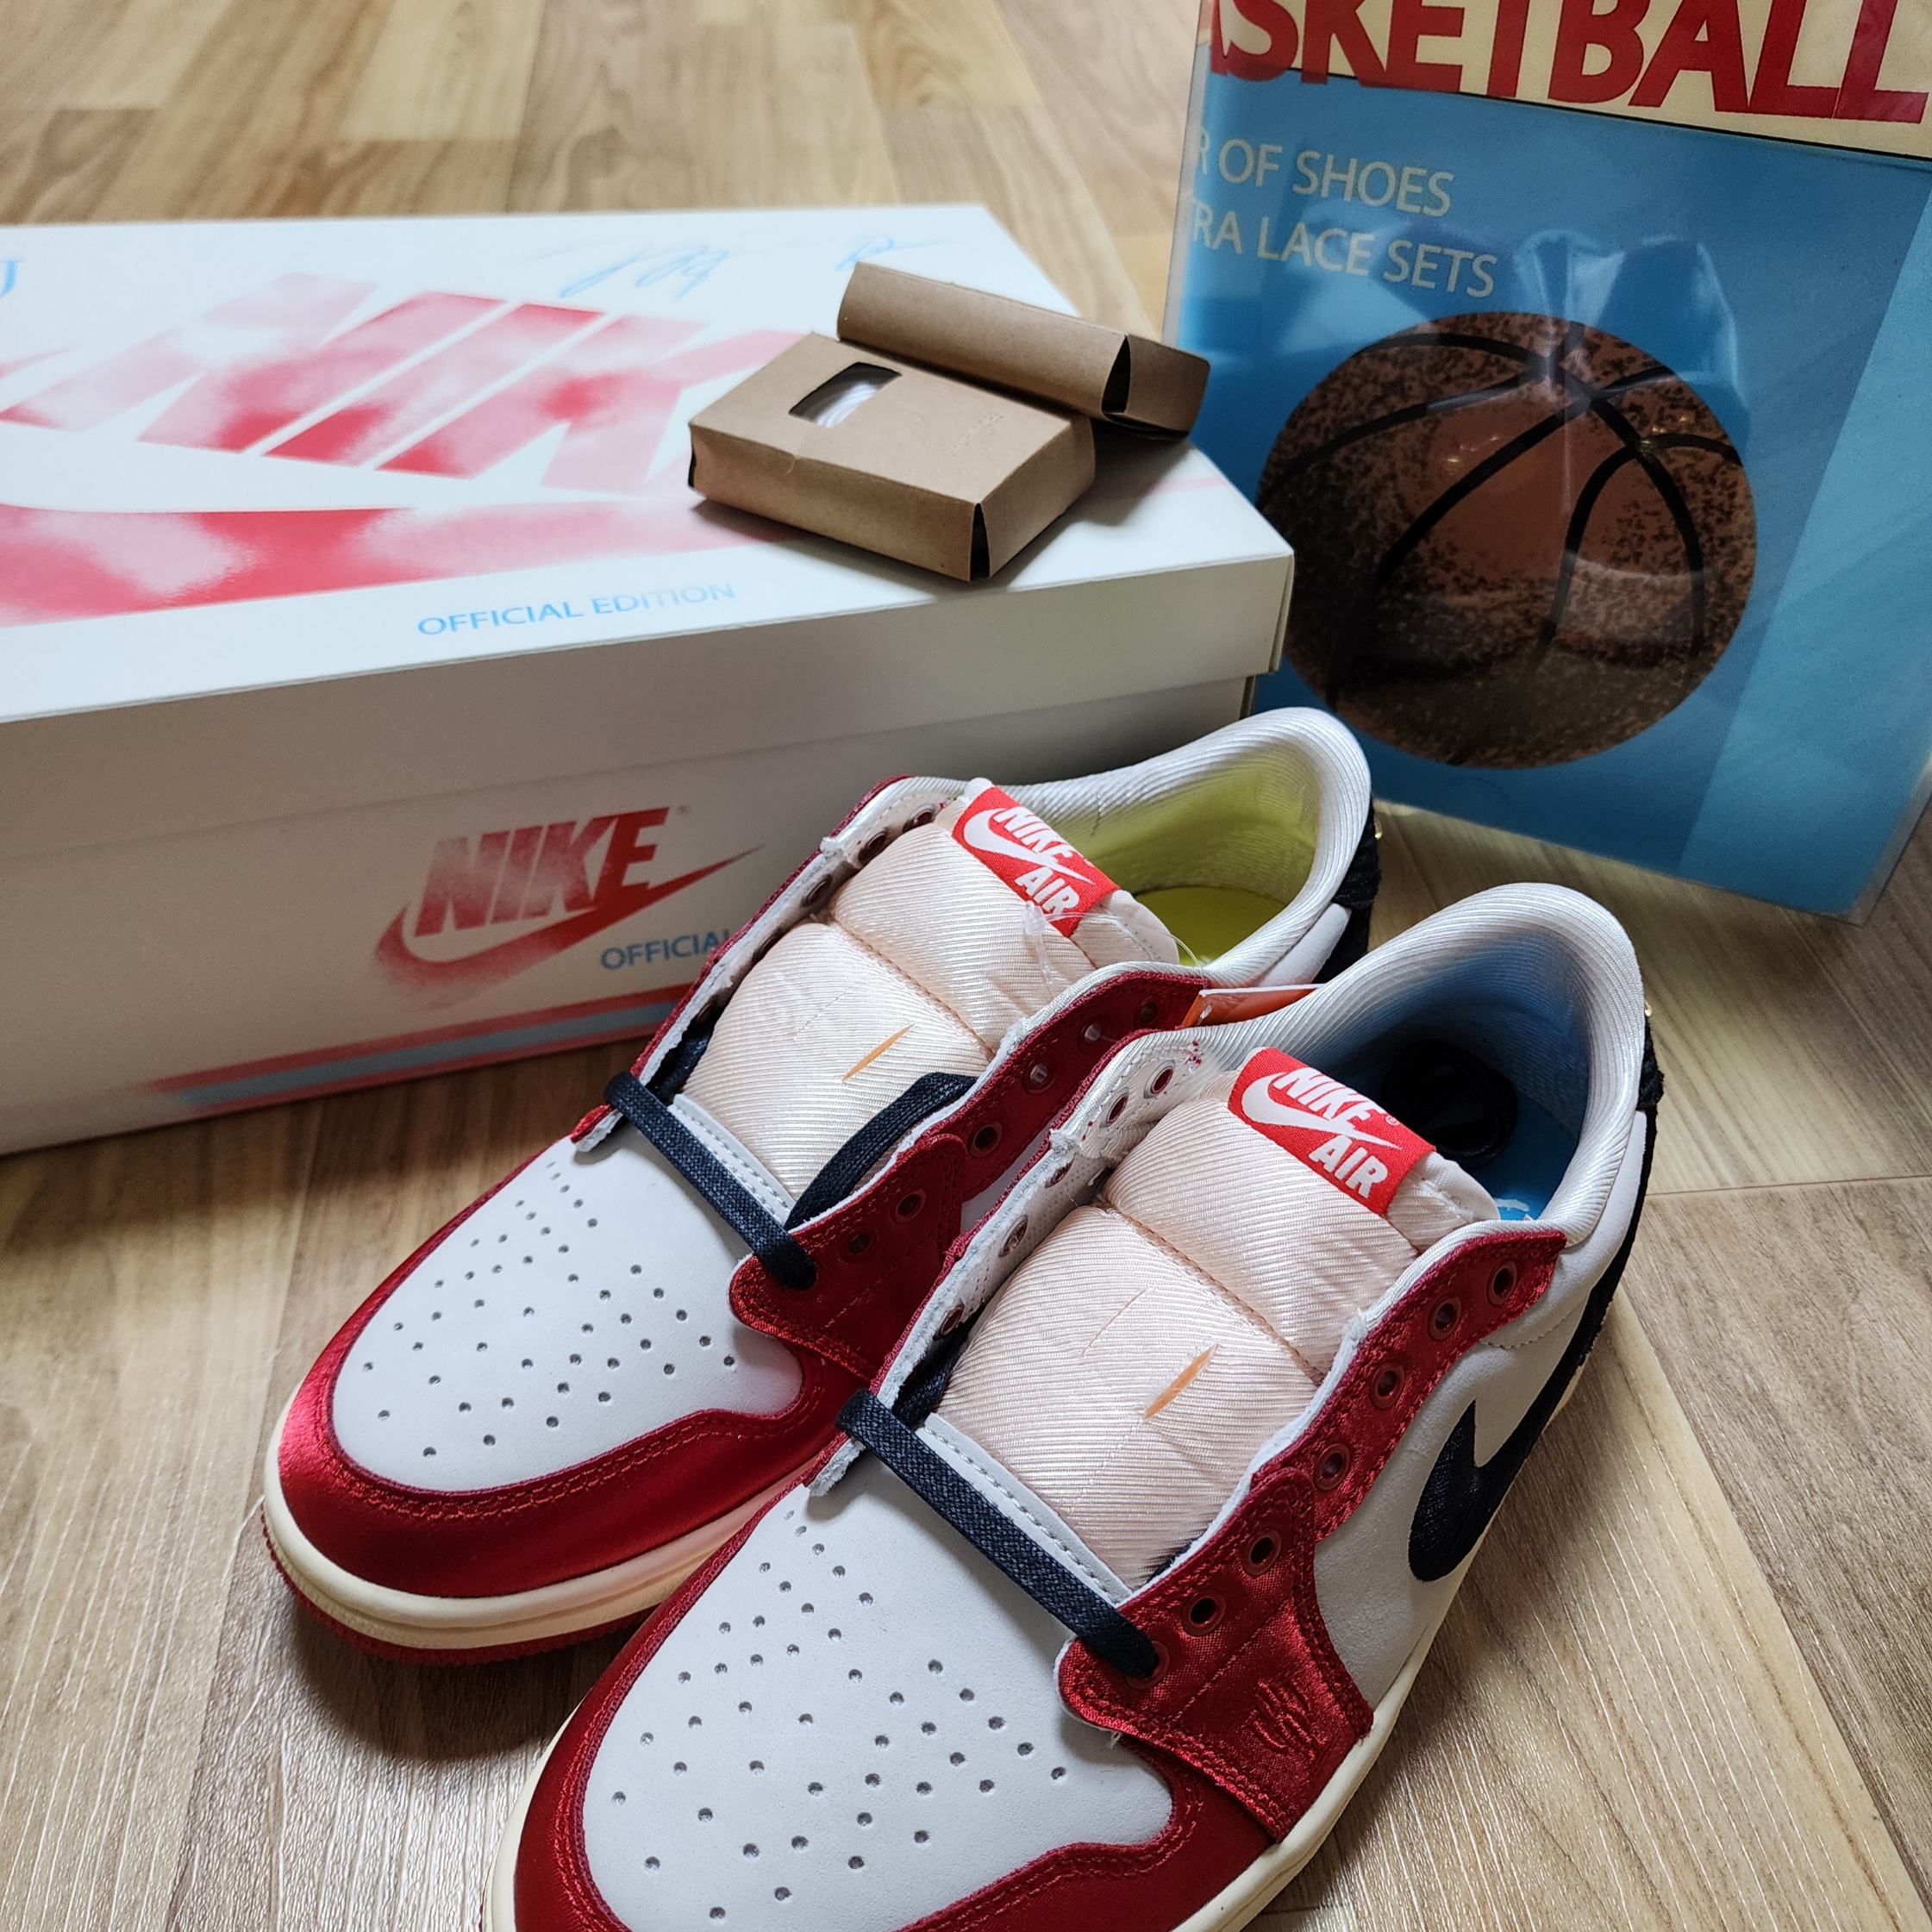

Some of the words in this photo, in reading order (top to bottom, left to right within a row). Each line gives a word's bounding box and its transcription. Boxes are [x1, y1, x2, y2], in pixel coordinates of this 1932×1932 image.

[1202, 0, 1929, 123] SKETBALL
[1218, 139, 1283, 187] OF
[1293, 150, 1454, 217] SHOES
[1257, 216, 1376, 277] LACE
[1382, 240, 1498, 298] SETS
[417, 602, 585, 635] OFFICIAL
[591, 583, 735, 615] EDITION
[416, 807, 670, 937] NIKE
[1014, 866, 1080, 916] AIR
[1272, 1066, 1388, 1131] NIKE
[1308, 1134, 1389, 1199] AIR
